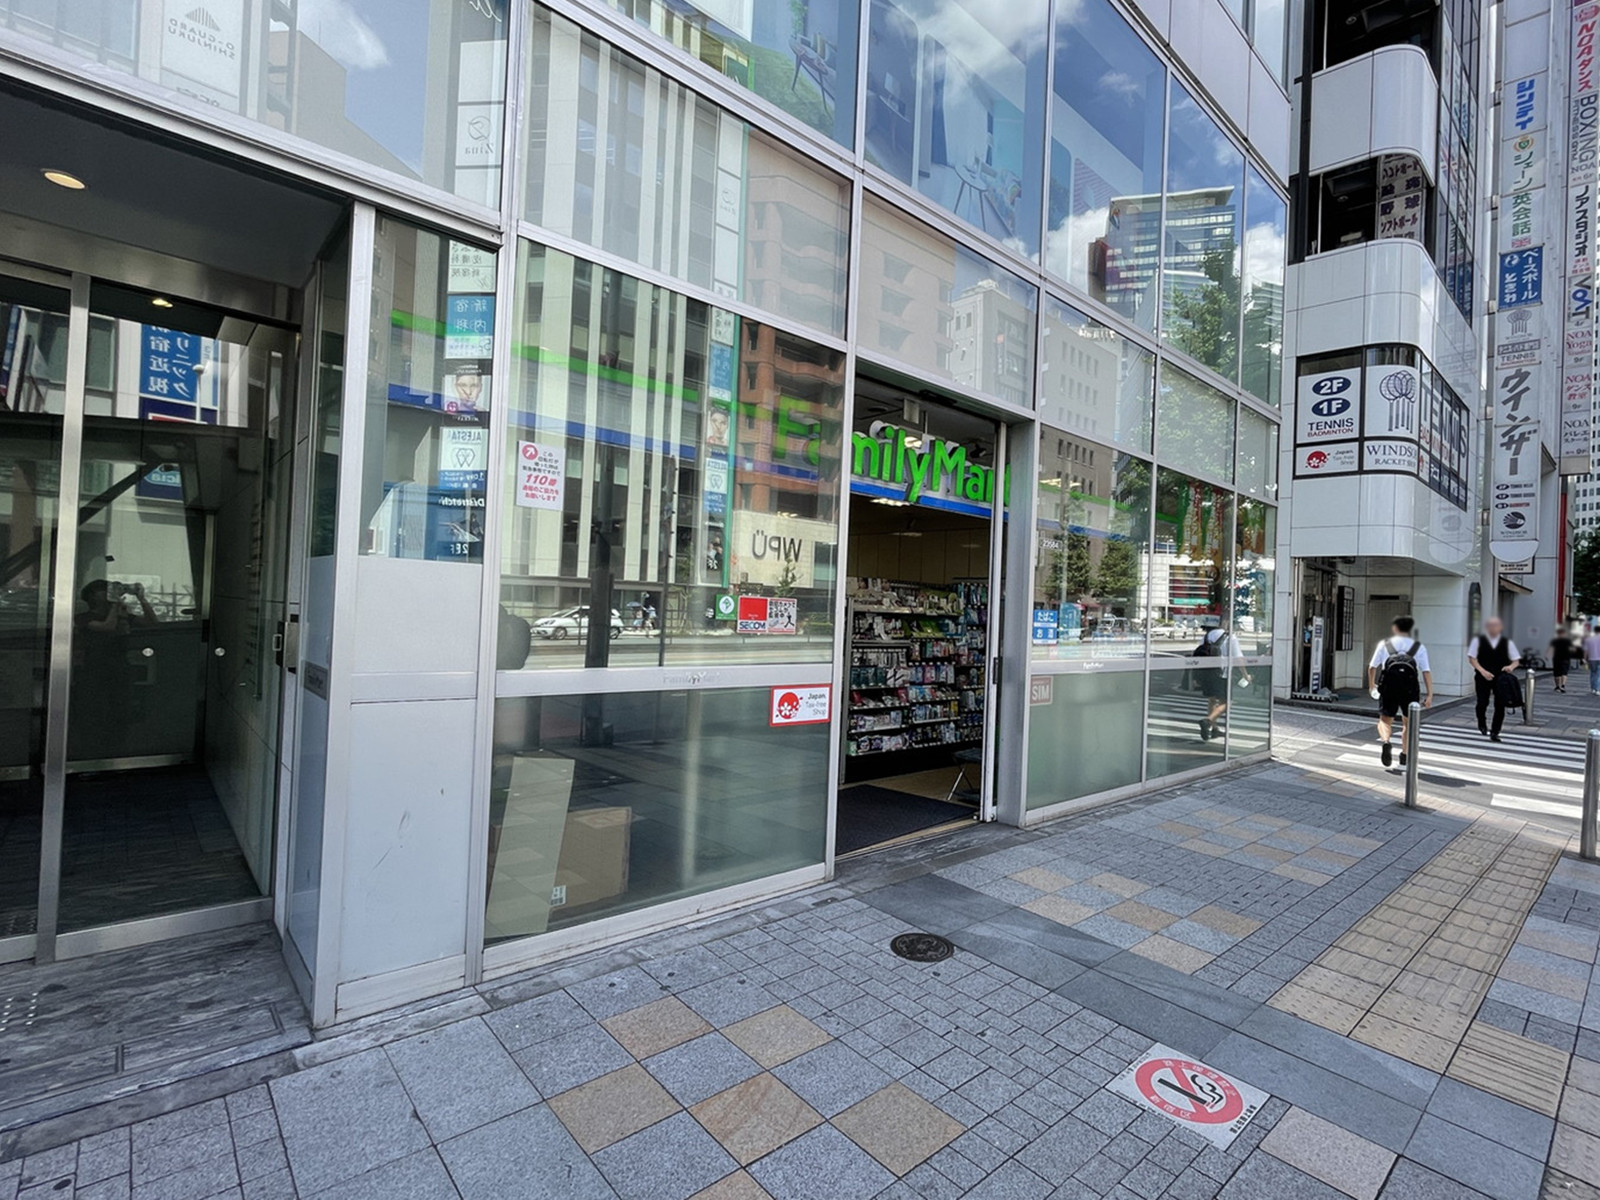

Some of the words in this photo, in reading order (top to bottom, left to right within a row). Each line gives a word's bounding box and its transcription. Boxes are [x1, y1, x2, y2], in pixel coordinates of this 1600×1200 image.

[1579, 94, 1598, 163] BOXING
[1571, 162, 1596, 174] NOA
[1381, 213, 1418, 234] ソフトボール
[1522, 248, 1539, 300] ベースボール
[1567, 330, 1592, 339] NOA
[1566, 340, 1592, 350] Yoga
[1501, 352, 1535, 362] TENNIS
[1565, 374, 1591, 384] NOA
[1320, 379, 1344, 394] 2F
[1319, 400, 1343, 414] 1F
[1308, 418, 1354, 431] TENNIS
[1564, 419, 1590, 430] NOA
[1307, 428, 1353, 438] BADMINTON
[740, 621, 766, 630] SECOM
[1031, 685, 1050, 701] SIM
